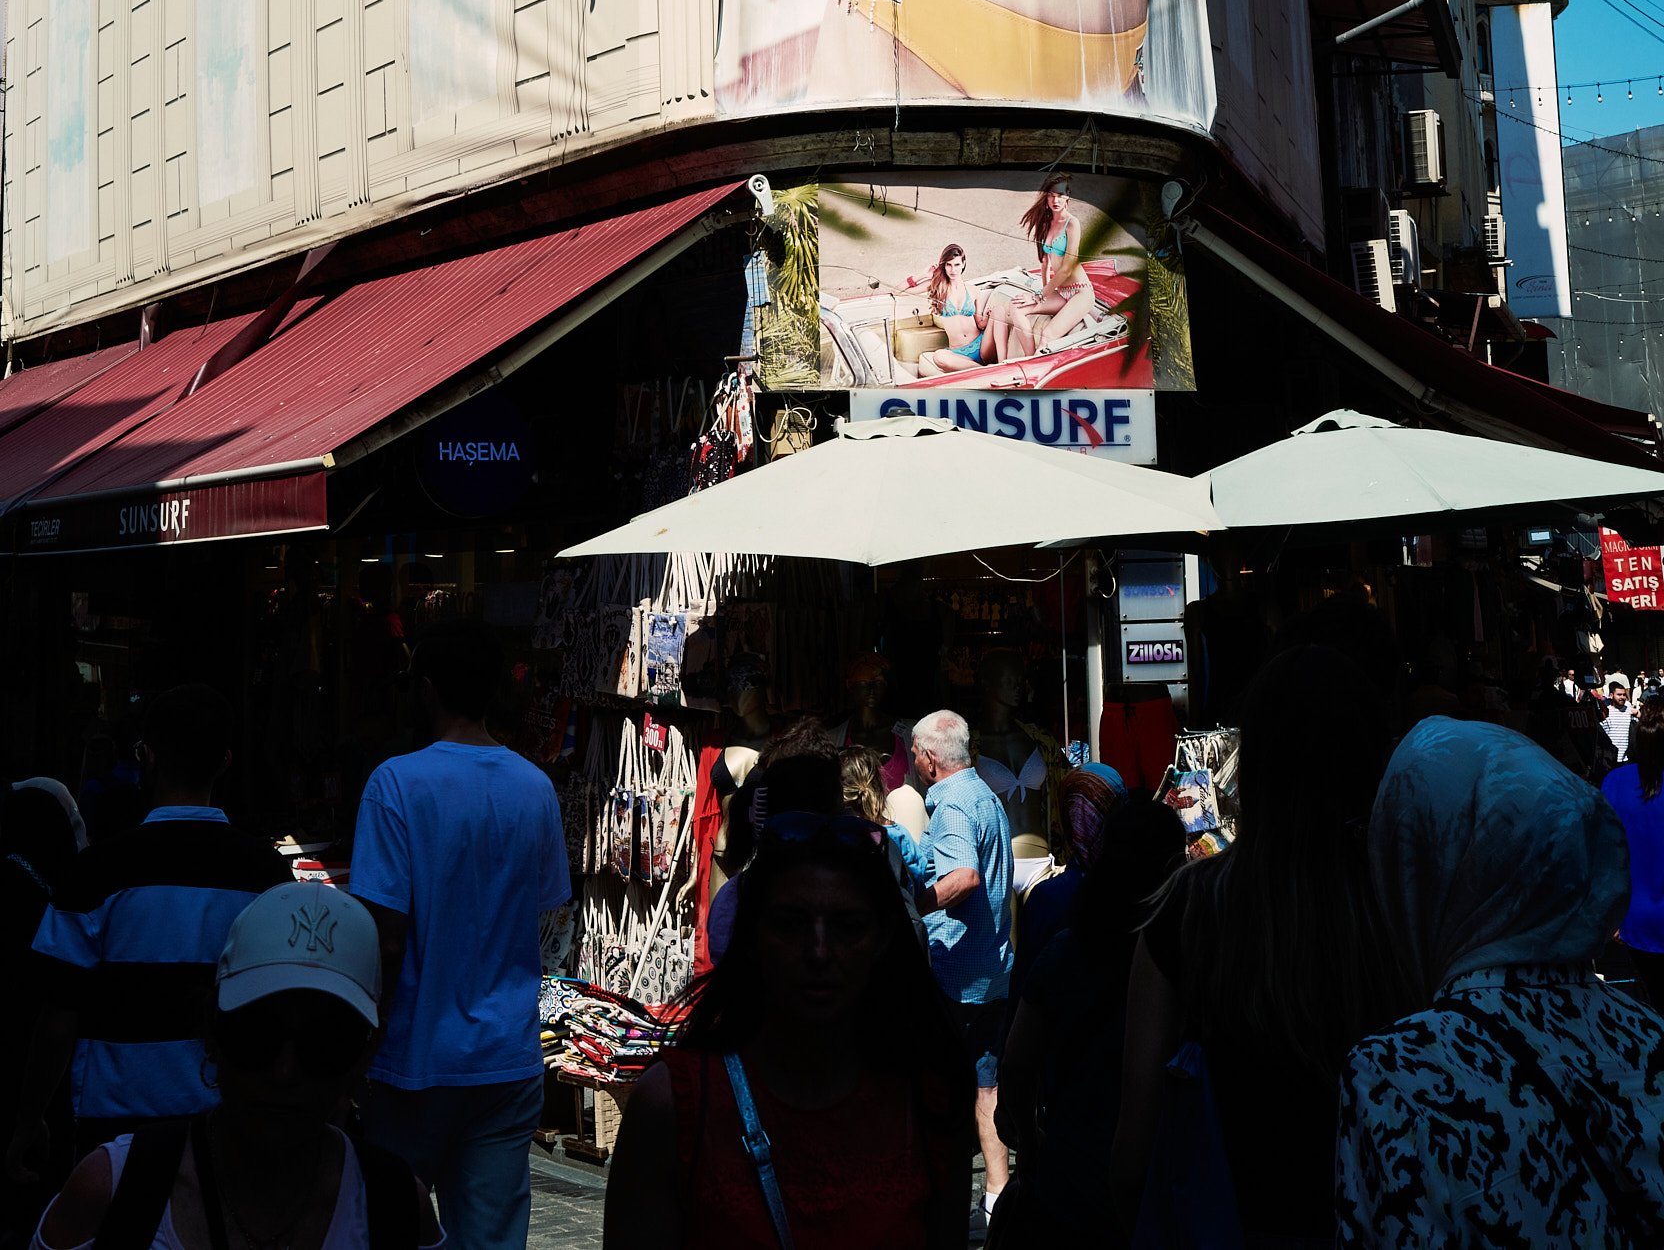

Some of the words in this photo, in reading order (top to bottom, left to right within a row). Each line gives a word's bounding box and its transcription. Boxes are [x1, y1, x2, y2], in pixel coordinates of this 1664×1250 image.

[438, 441, 521, 467] HAŞEMA
[118, 499, 191, 538] SUNSURF
[1611, 576, 1660, 592] SATIŞ
